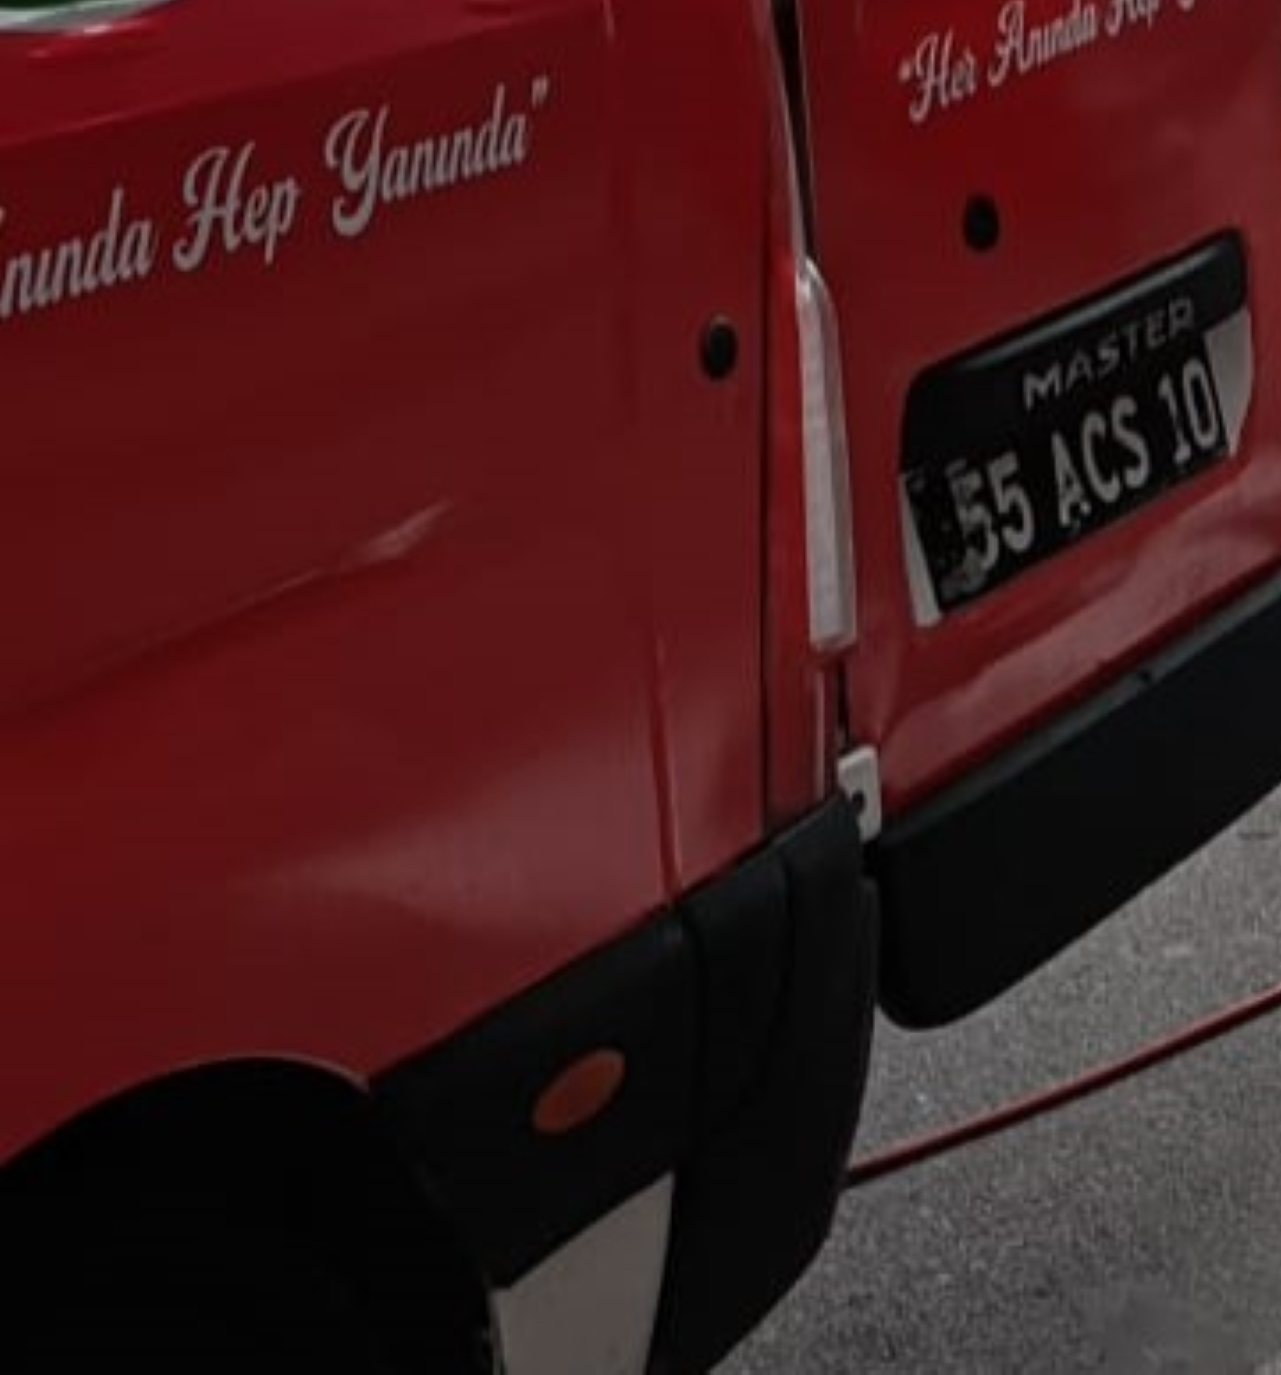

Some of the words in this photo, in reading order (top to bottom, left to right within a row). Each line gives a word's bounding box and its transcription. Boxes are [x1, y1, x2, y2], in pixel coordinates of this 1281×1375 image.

[0, 187, 157, 317] nında
[172, 140, 300, 273] Hep
[1022, 297, 1196, 411] MASTER
[944, 449, 1035, 572] 55
[1050, 393, 1151, 526] ACS
[1157, 358, 1221, 465] 10
